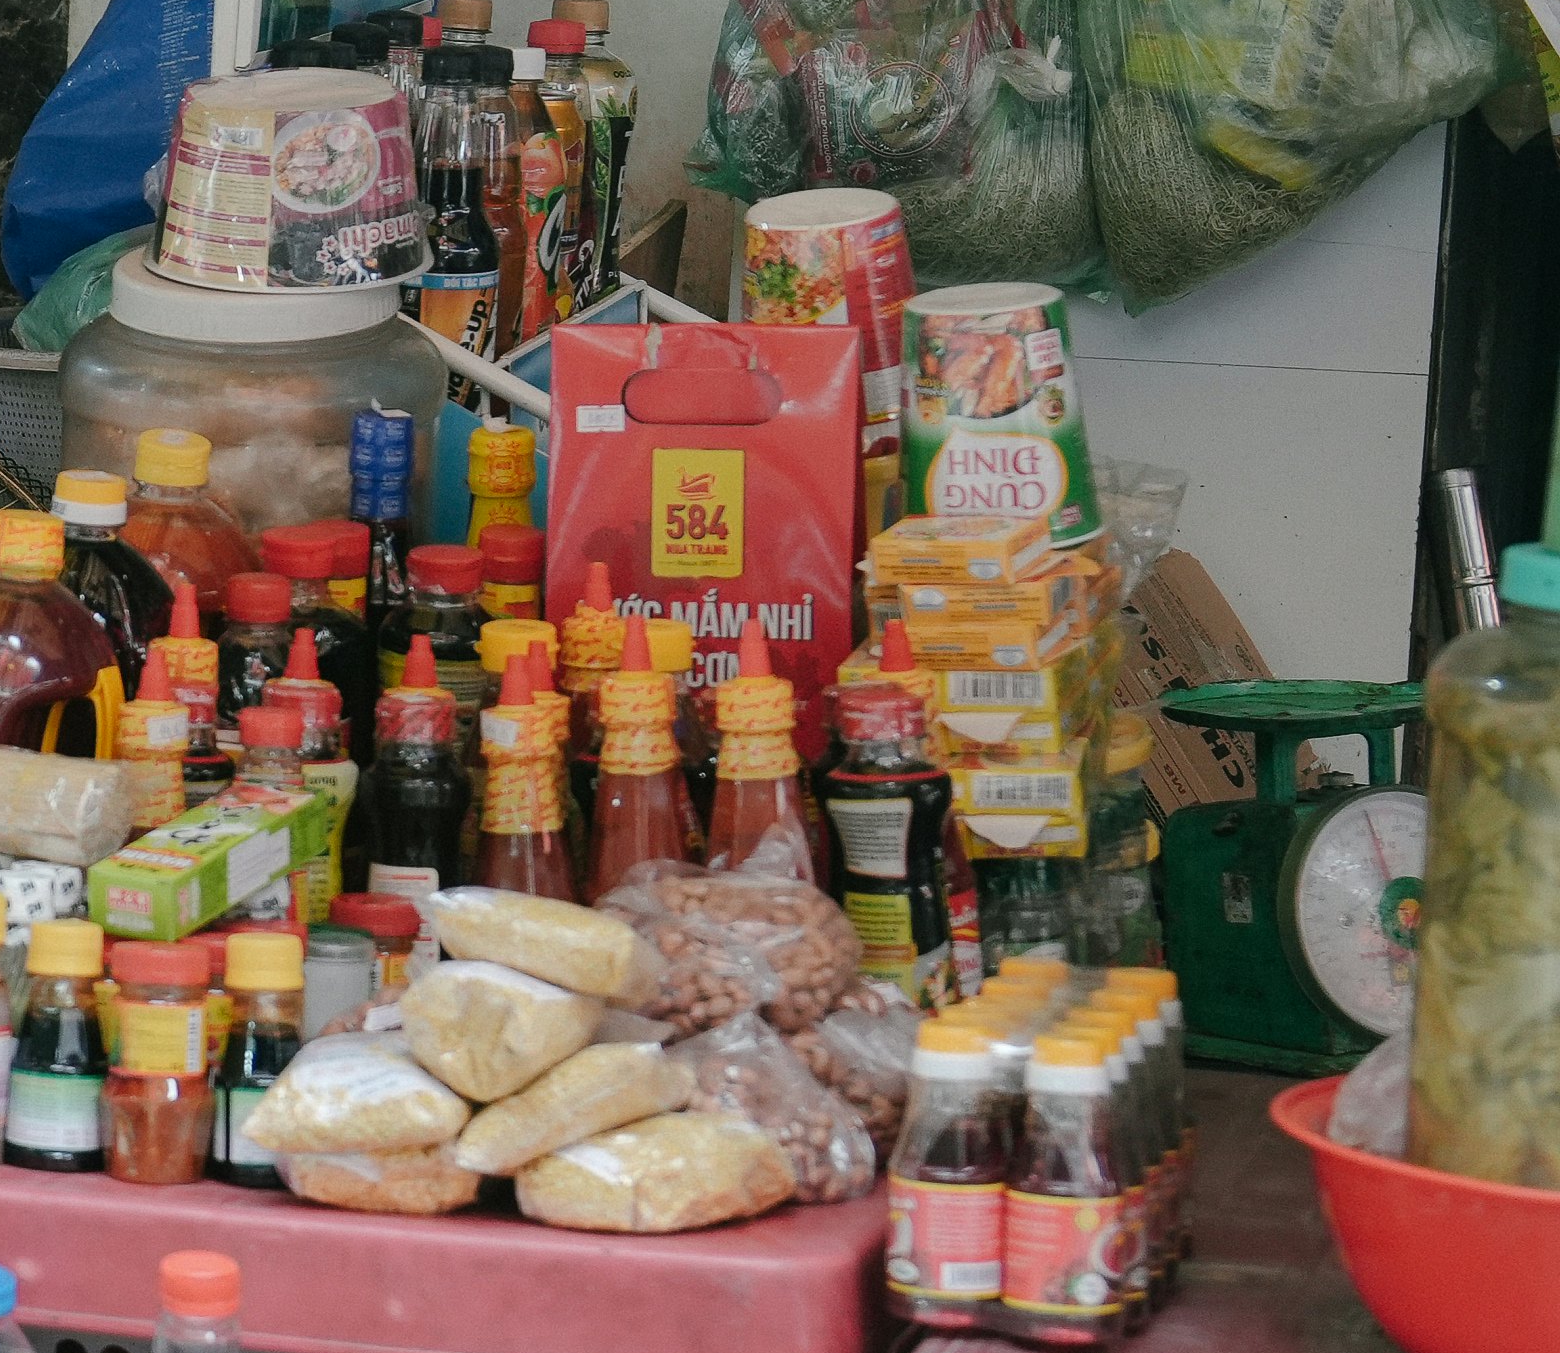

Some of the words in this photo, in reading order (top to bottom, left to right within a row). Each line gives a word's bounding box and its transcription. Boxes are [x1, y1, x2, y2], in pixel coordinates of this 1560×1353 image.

[946, 443, 1042, 479] ĐÌNH
[943, 480, 1047, 511] CUNG
[666, 504, 729, 539] 584
[757, 593, 815, 640] NHỈ
